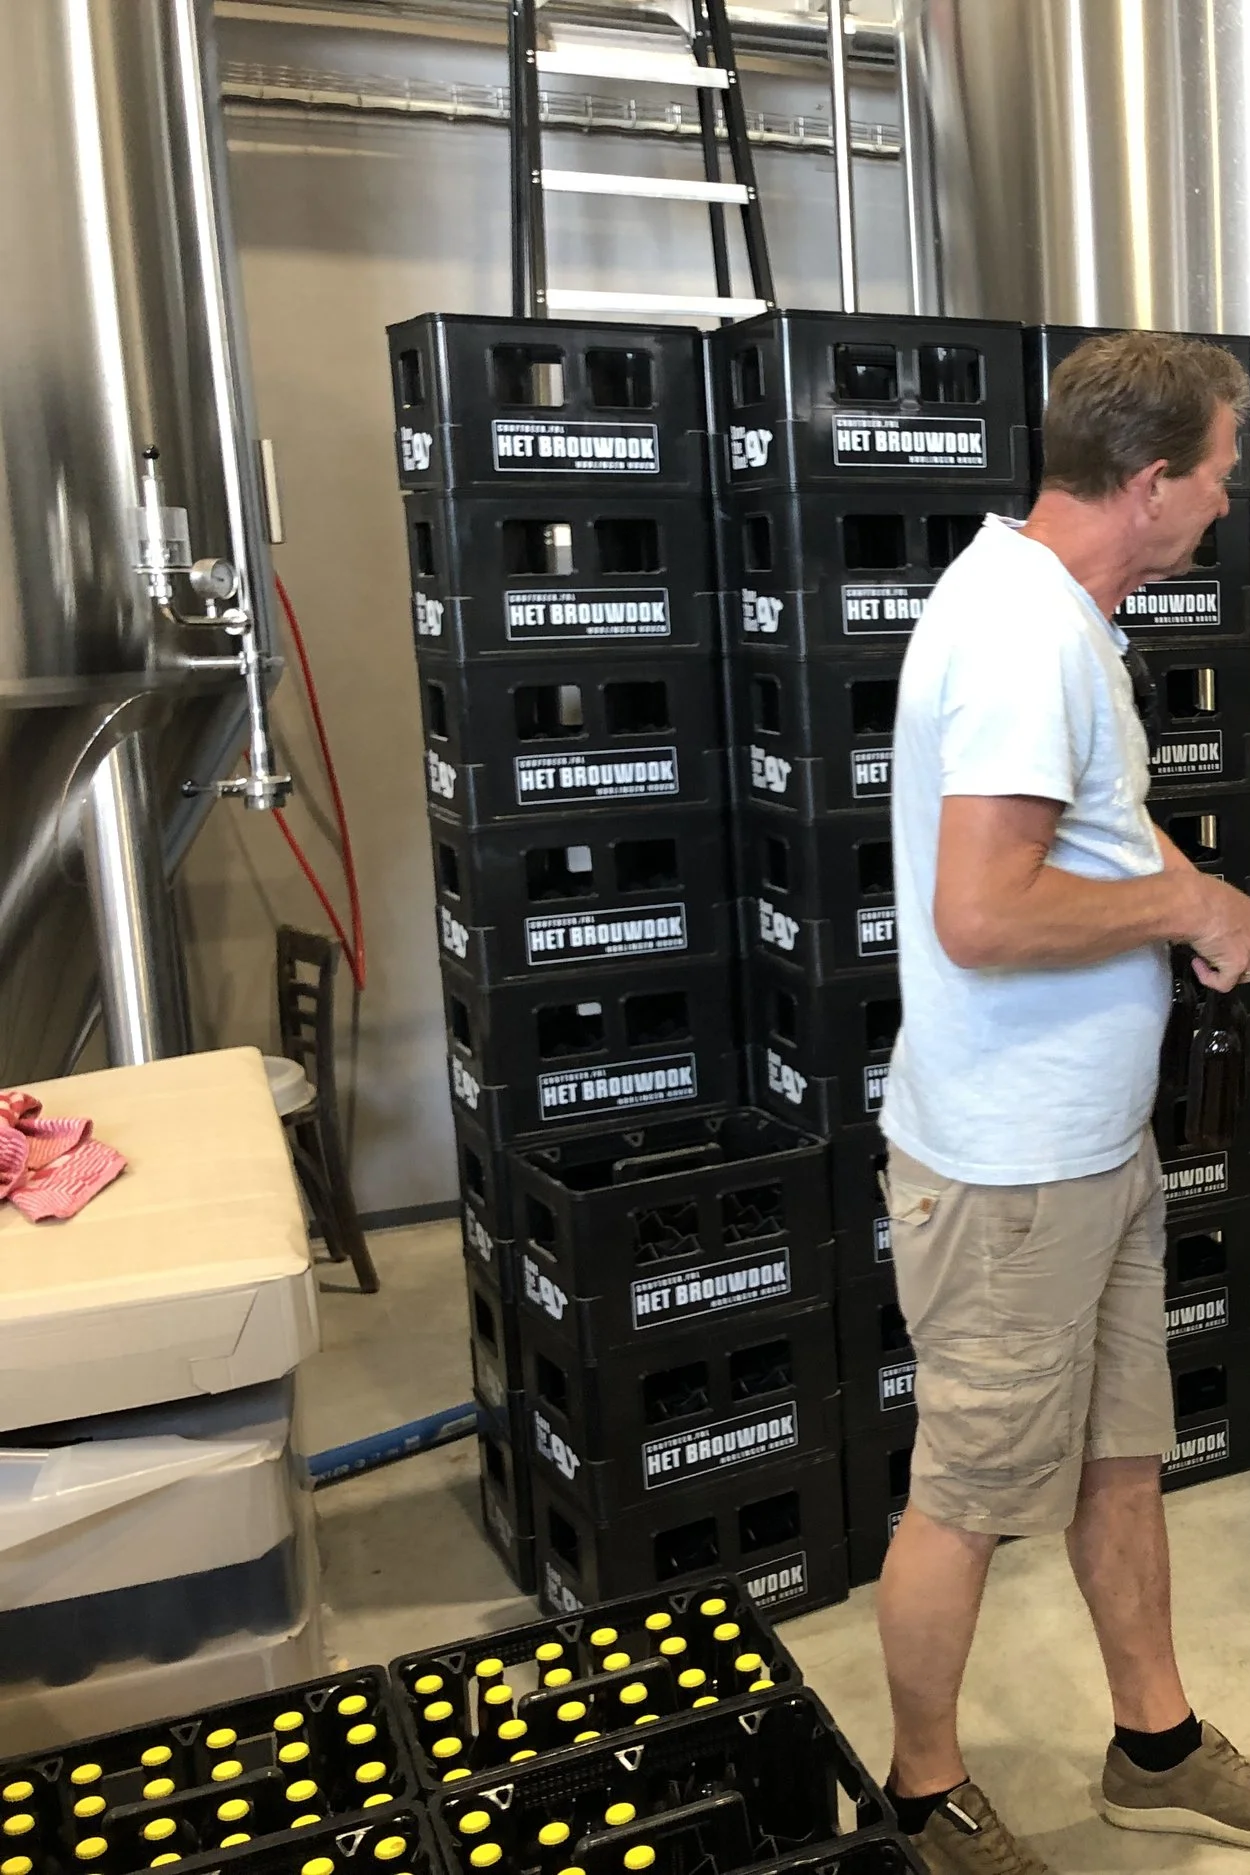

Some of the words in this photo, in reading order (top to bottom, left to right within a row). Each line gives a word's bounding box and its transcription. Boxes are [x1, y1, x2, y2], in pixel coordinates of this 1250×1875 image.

[498, 435, 534, 457] HET
[539, 436, 654, 459] BROUWDOK
[838, 430, 872, 451] HET
[875, 431, 982, 453] BROUWDOK
[510, 604, 545, 626] HET
[550, 602, 665, 625] BROUWDOK
[847, 600, 880, 620] HET
[1126, 594, 1217, 614] BROUWDOK
[521, 768, 555, 791] HET
[560, 760, 674, 788] BROUWDOK
[856, 763, 888, 784] HET
[530, 928, 565, 951] HET
[570, 916, 682, 947] BROUWDOK
[862, 920, 894, 943] HET
[544, 1083, 577, 1107] HET
[582, 1065, 692, 1101] BROUWDOK
[1160, 1163, 1224, 1191] OUWDOK
[636, 1288, 671, 1316] HET
[675, 1261, 786, 1306] BROUWDOK
[884, 1374, 913, 1397] HET
[648, 1449, 682, 1475] HET
[685, 1415, 794, 1464] BROUWDOK
[747, 1564, 803, 1599] WDOK
